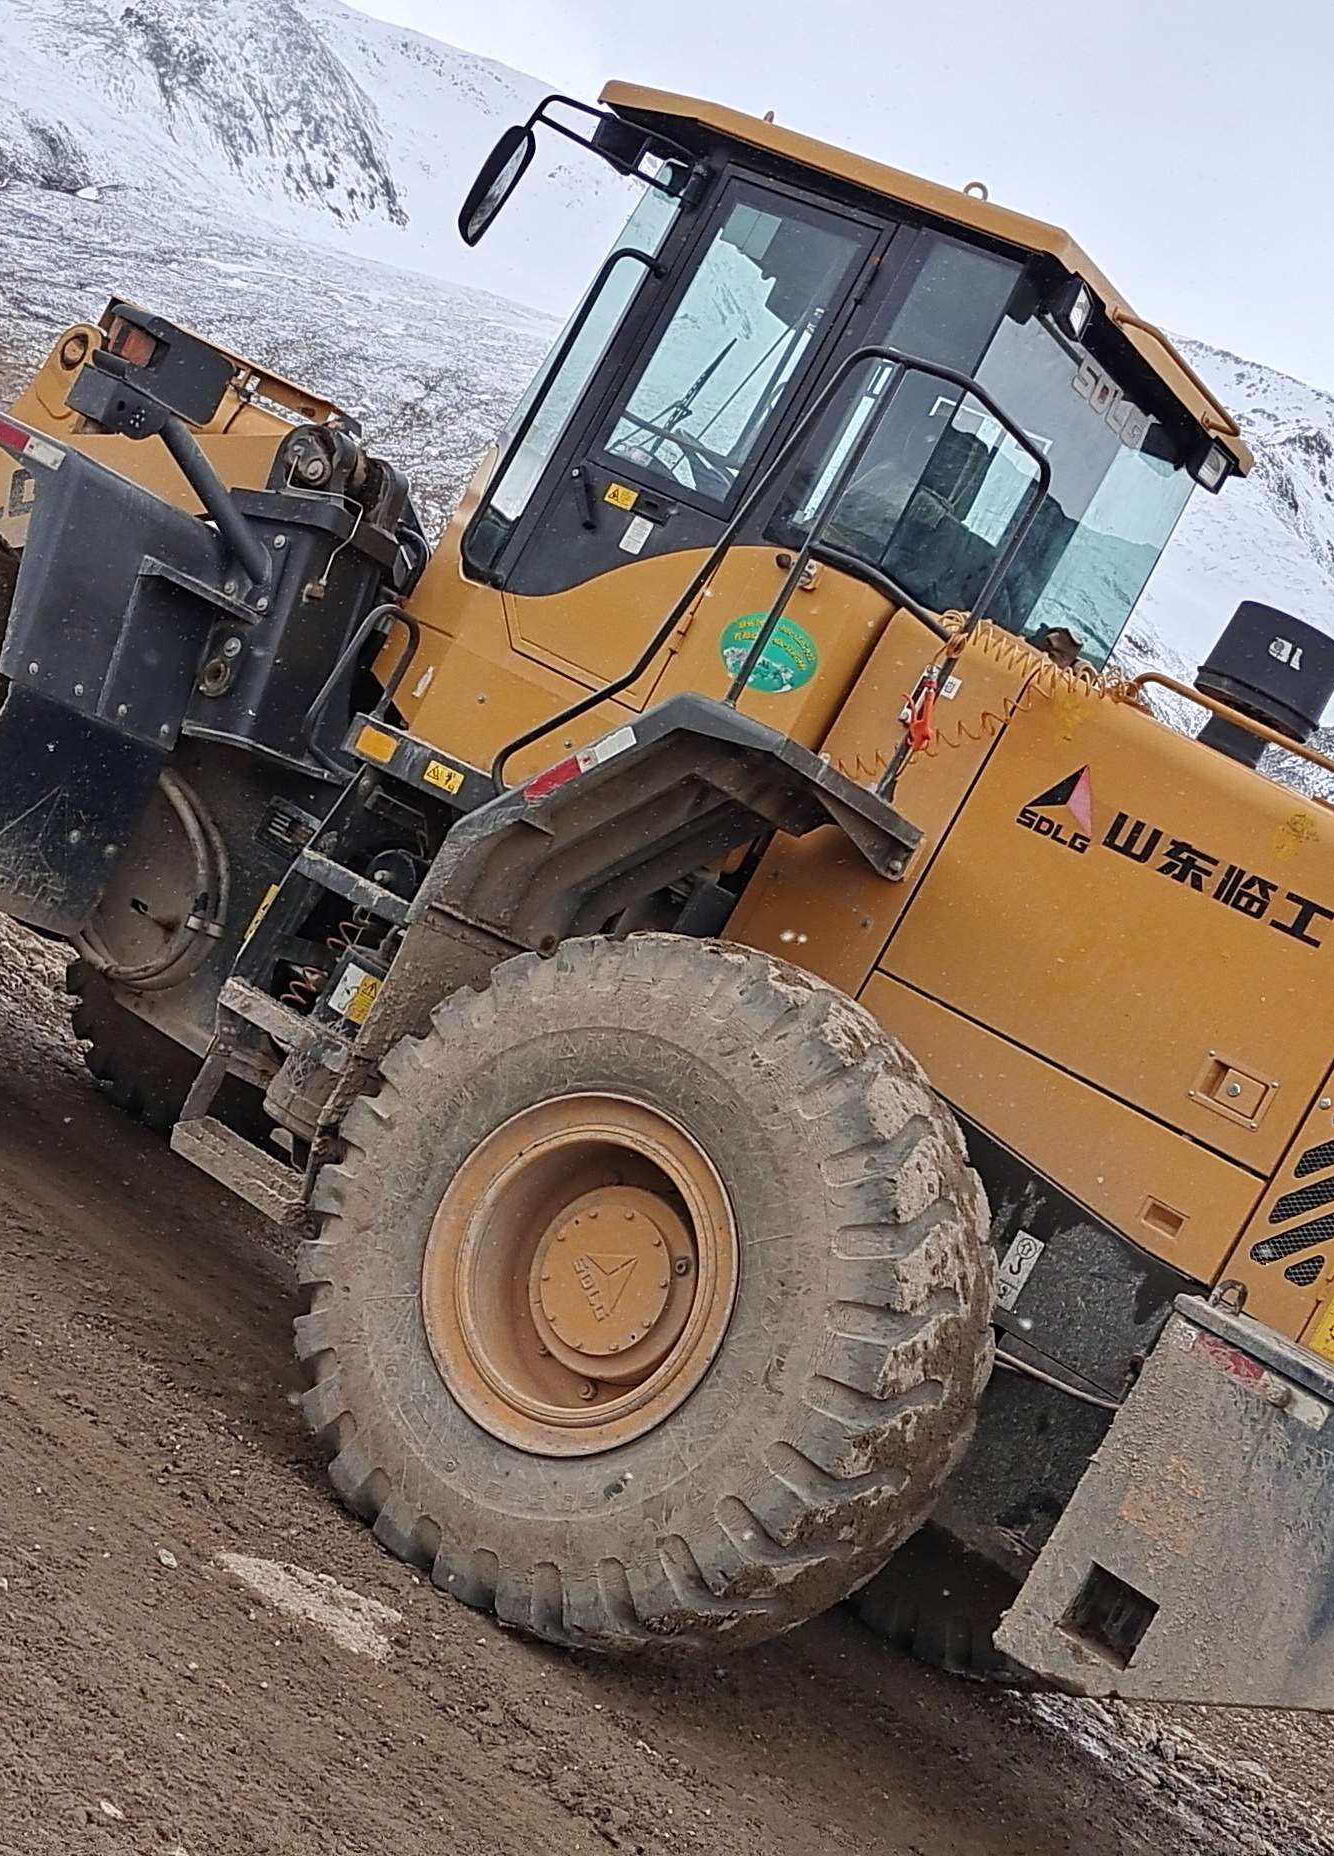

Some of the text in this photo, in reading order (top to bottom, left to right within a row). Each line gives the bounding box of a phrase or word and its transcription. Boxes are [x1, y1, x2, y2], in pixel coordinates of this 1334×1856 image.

[1071, 356, 1152, 450] SDLG
[1015, 806, 1093, 855] SDLG
[571, 1257, 611, 1323] SDLG
